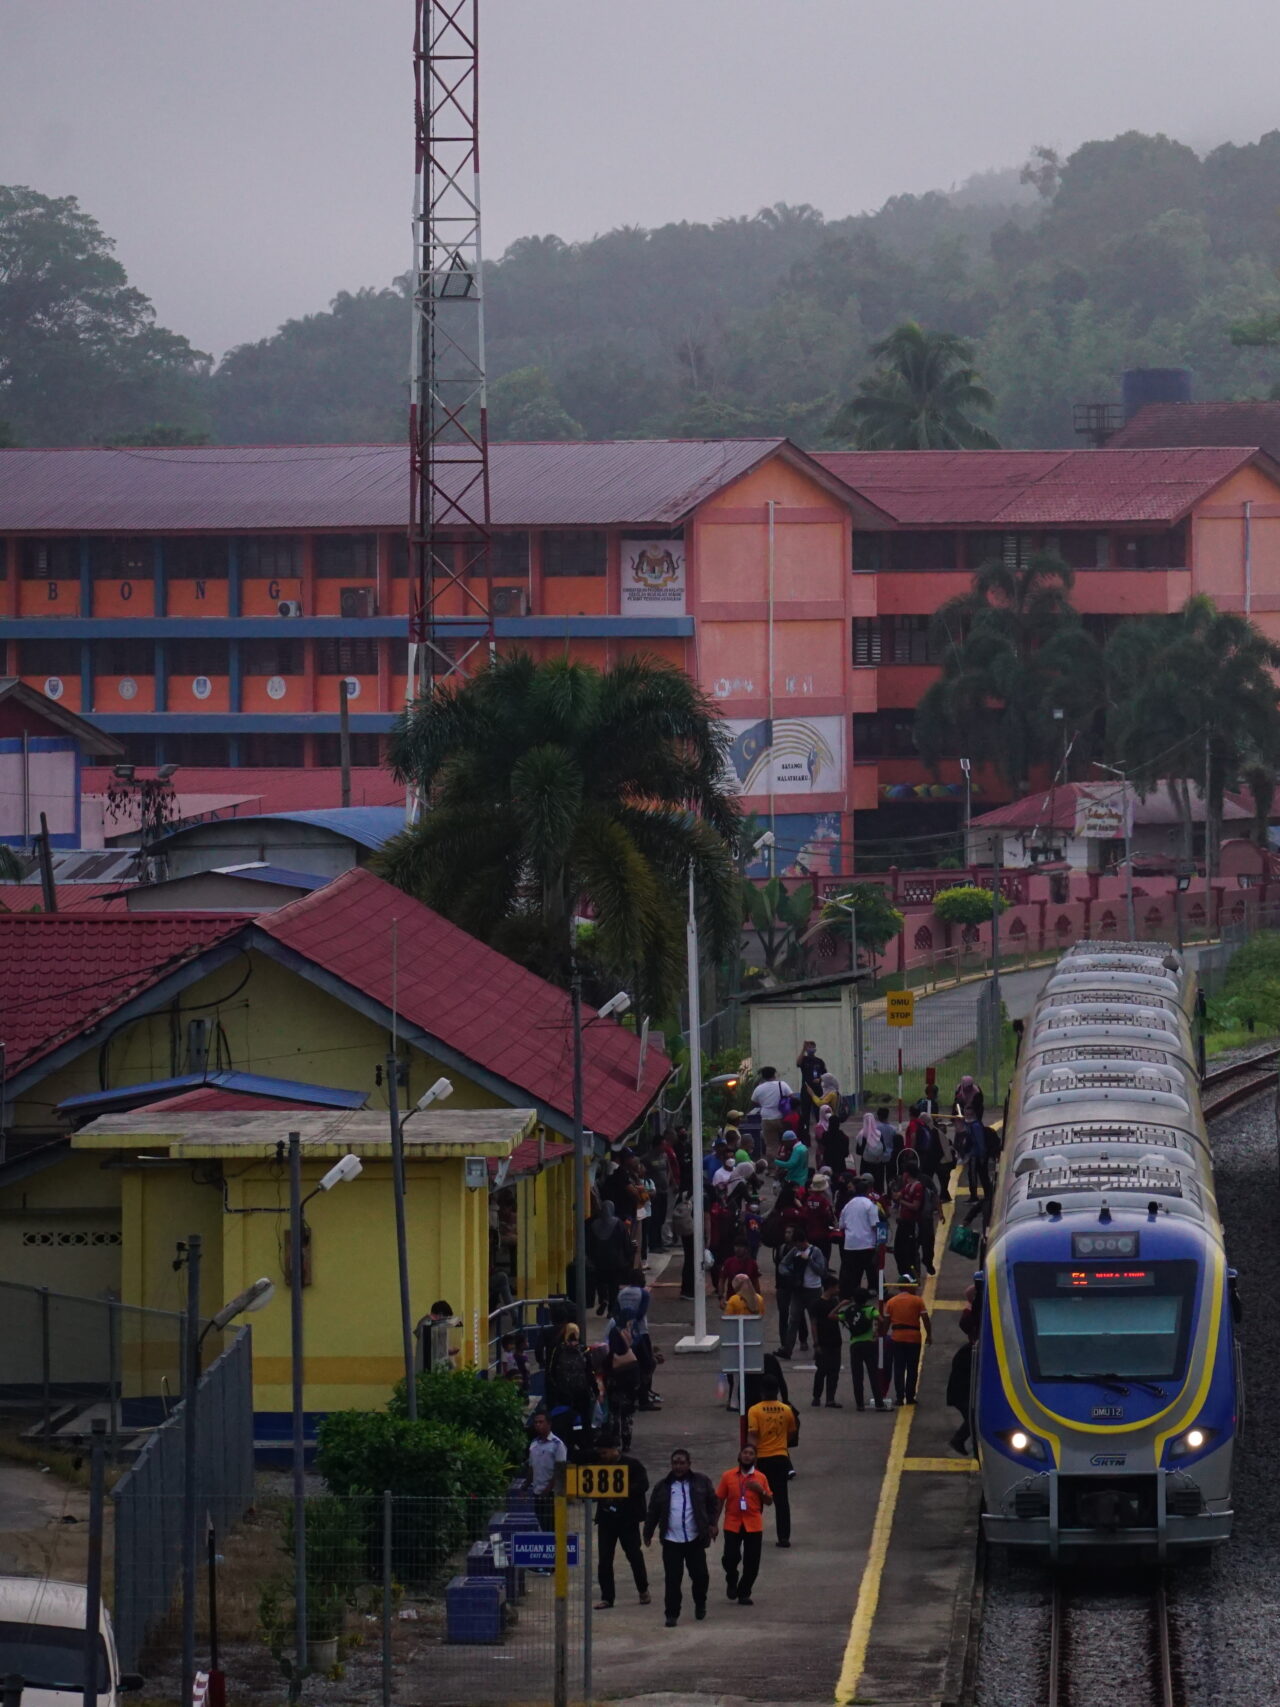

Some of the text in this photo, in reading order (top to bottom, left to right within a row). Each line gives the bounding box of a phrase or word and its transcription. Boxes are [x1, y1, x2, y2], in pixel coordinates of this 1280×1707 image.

[1093, 1408, 1121, 1416] DMU 12
[582, 1469, 625, 1494] 388
[515, 1544, 577, 1553] LALUAN KEAR
